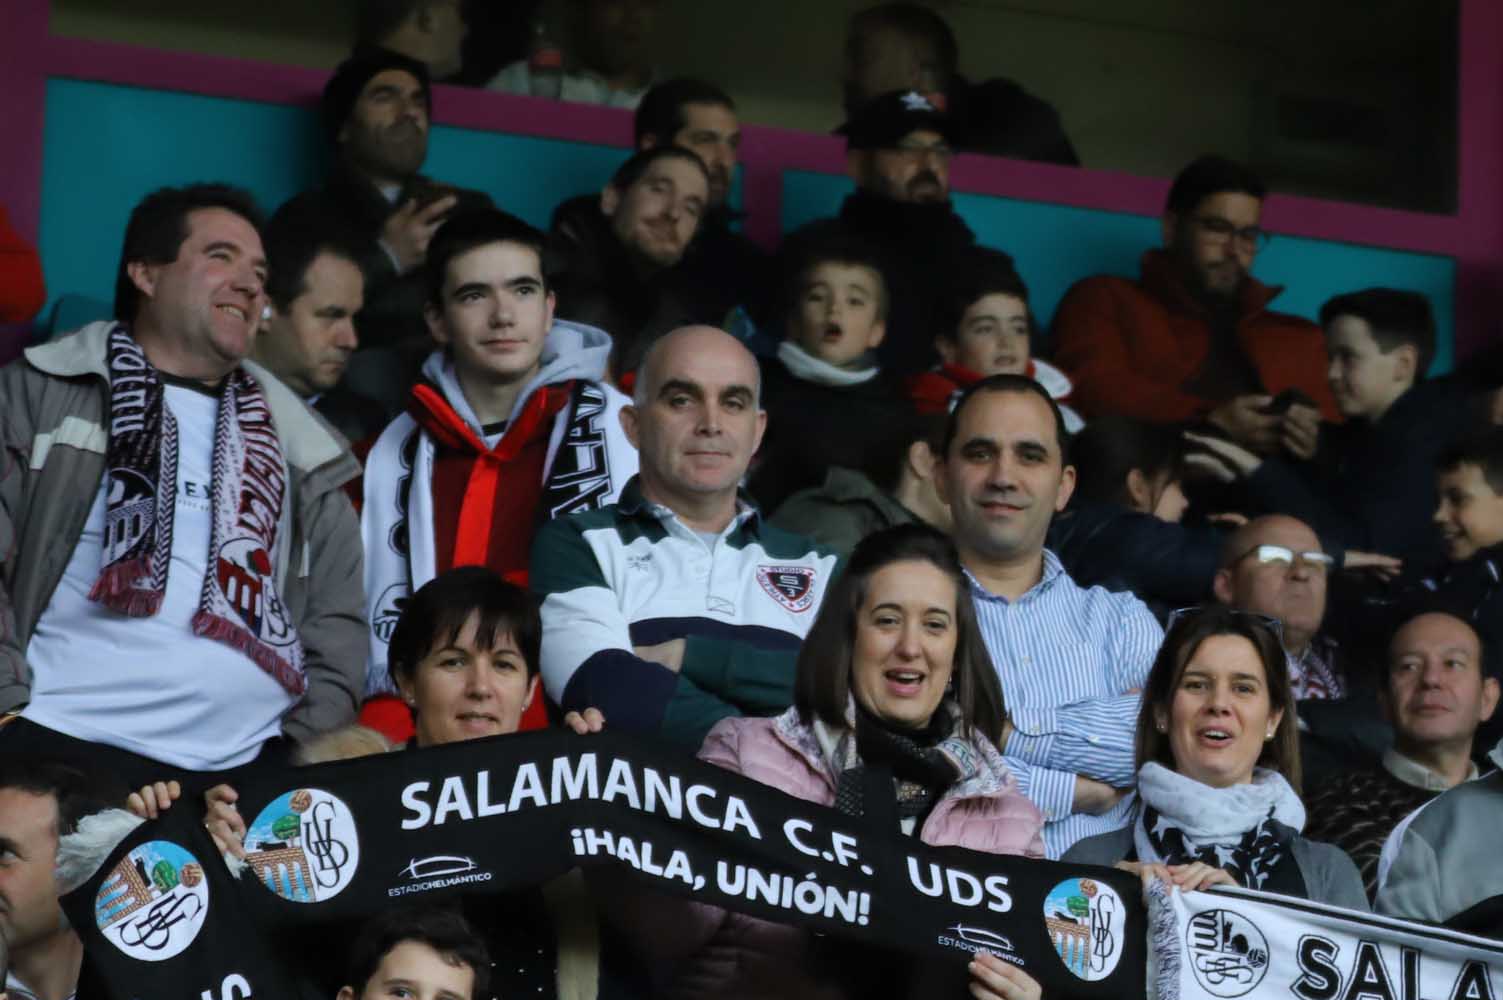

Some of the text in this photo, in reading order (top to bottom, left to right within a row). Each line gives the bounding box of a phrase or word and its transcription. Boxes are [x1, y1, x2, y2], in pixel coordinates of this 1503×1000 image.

[401, 752, 1013, 913] SALAMANCA C.F. UDS
[570, 827, 871, 926] ¡HALA, UNIÓN!
